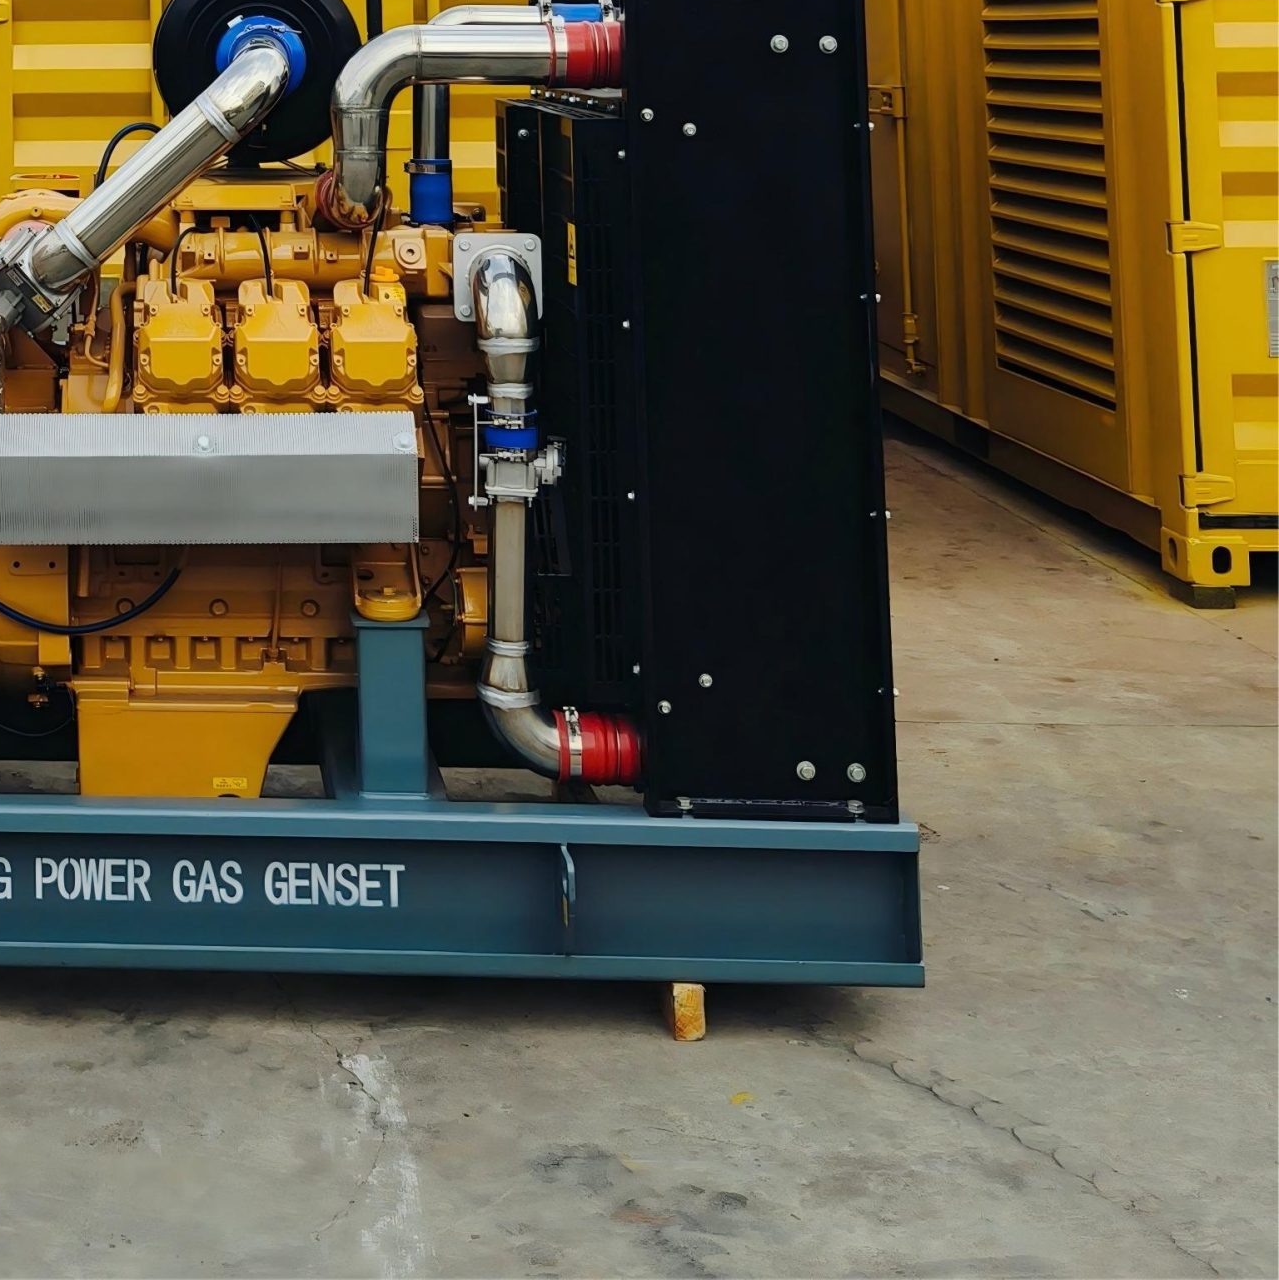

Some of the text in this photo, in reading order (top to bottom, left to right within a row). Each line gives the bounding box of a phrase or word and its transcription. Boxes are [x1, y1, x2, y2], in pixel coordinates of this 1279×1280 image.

[35, 857, 152, 902] POWER
[172, 859, 244, 904] GAS
[264, 861, 406, 908] GENSET
